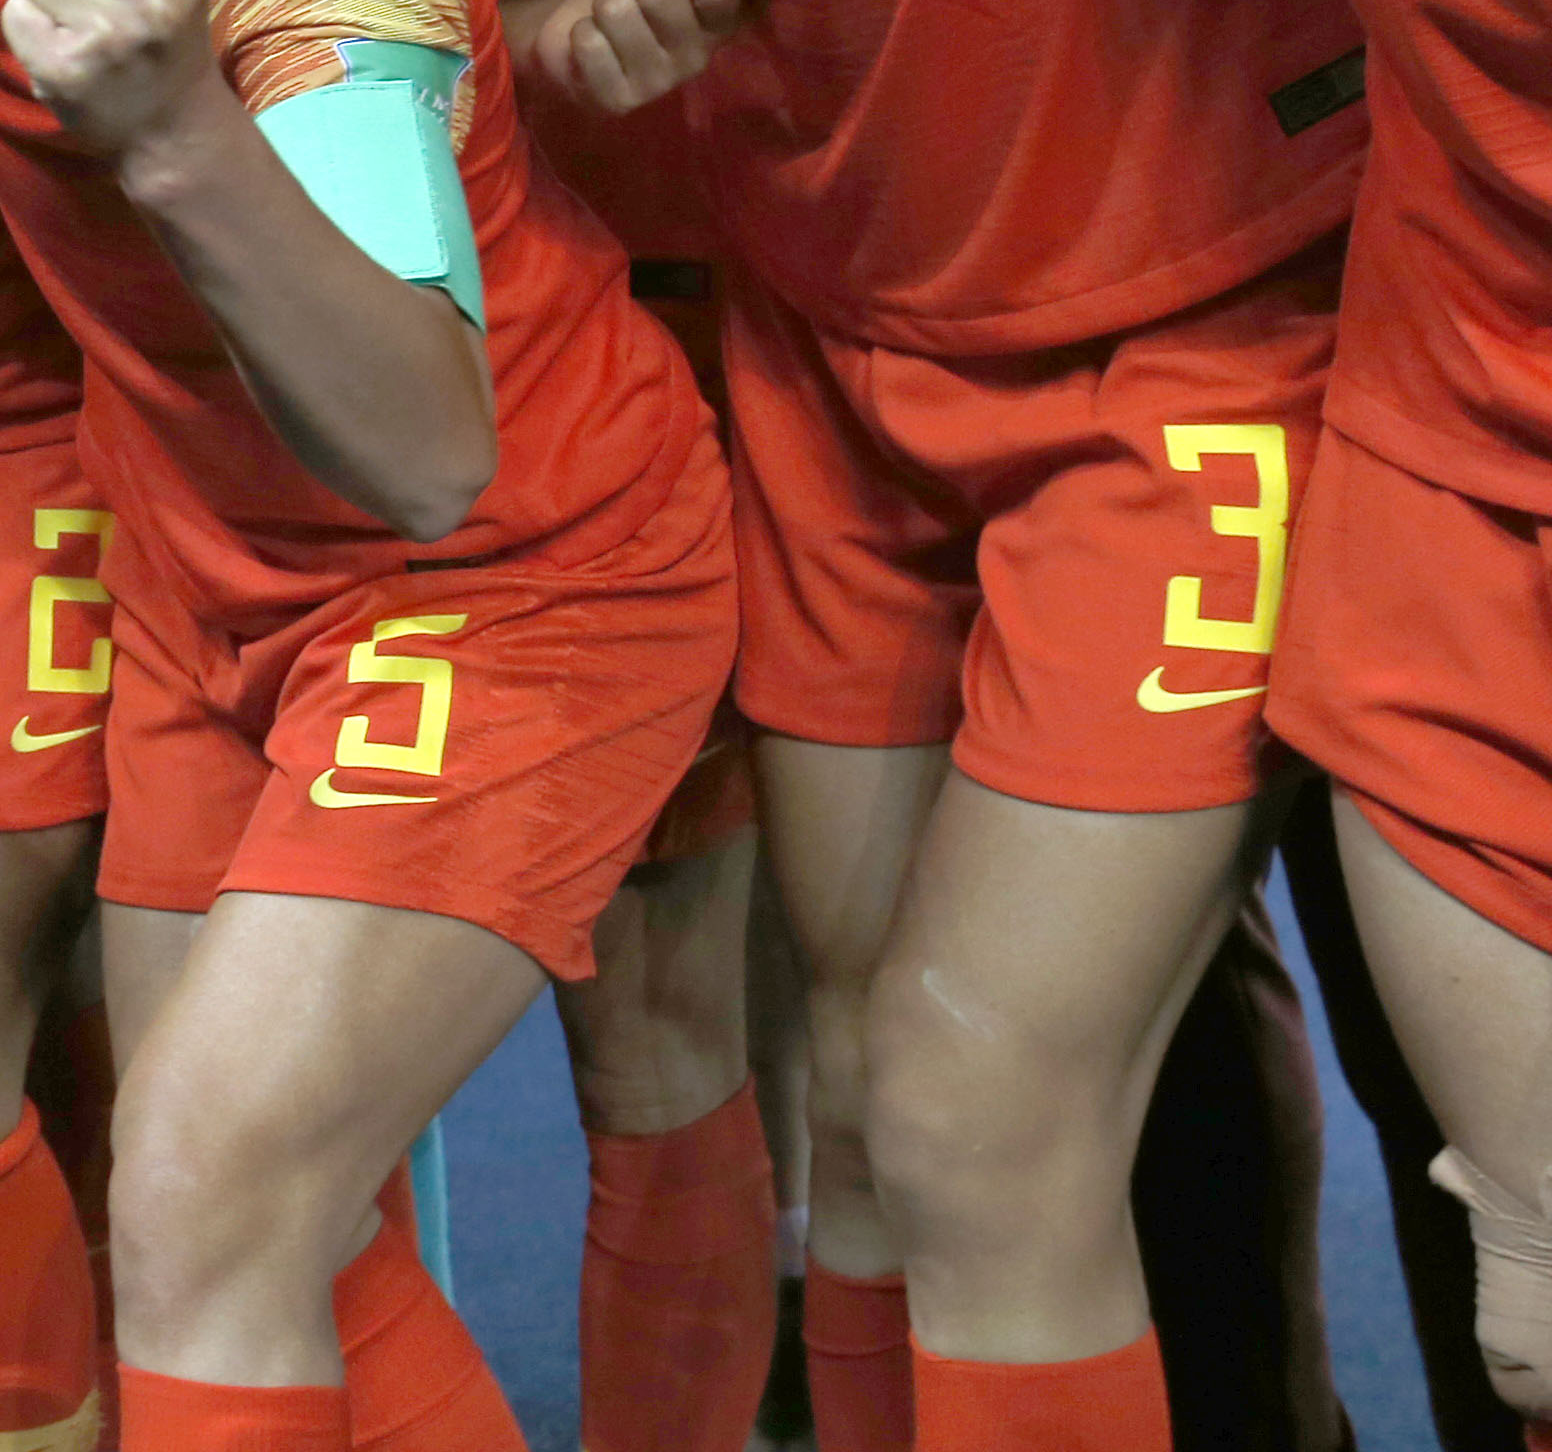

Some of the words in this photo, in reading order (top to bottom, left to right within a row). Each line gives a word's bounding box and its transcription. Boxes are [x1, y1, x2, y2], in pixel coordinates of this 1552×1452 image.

[27, 509, 116, 694] 2
[1163, 424, 1289, 653] 3
[335, 613, 469, 776] 5
